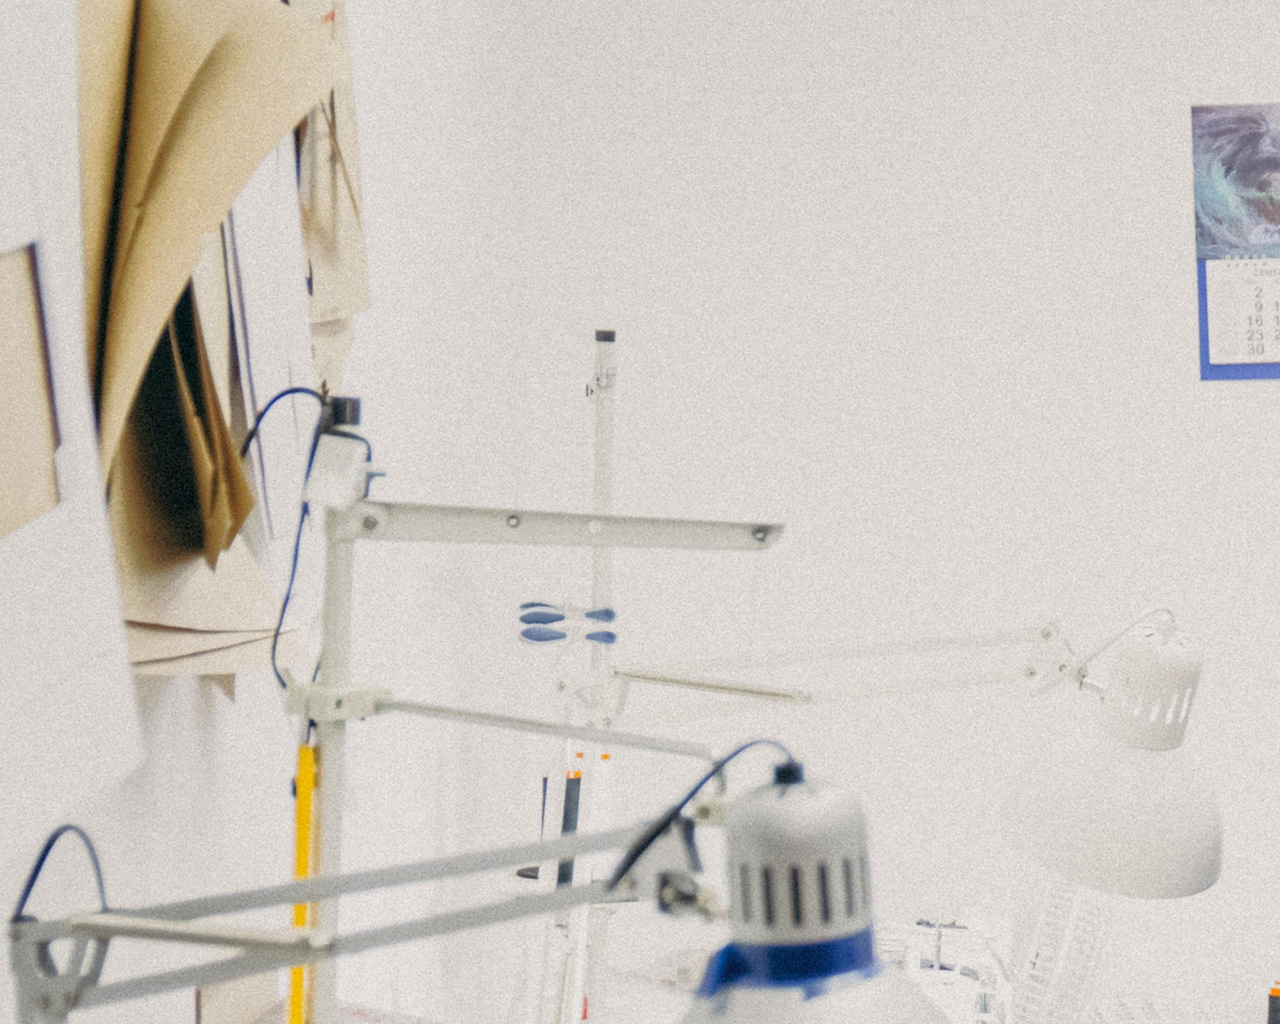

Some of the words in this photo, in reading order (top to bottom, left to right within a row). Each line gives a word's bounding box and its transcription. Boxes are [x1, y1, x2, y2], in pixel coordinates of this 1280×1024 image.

[1254, 286, 1263, 298] 2
[1254, 300, 1263, 313] 9
[1247, 329, 1264, 341] 23
[1247, 343, 1265, 355] 30
